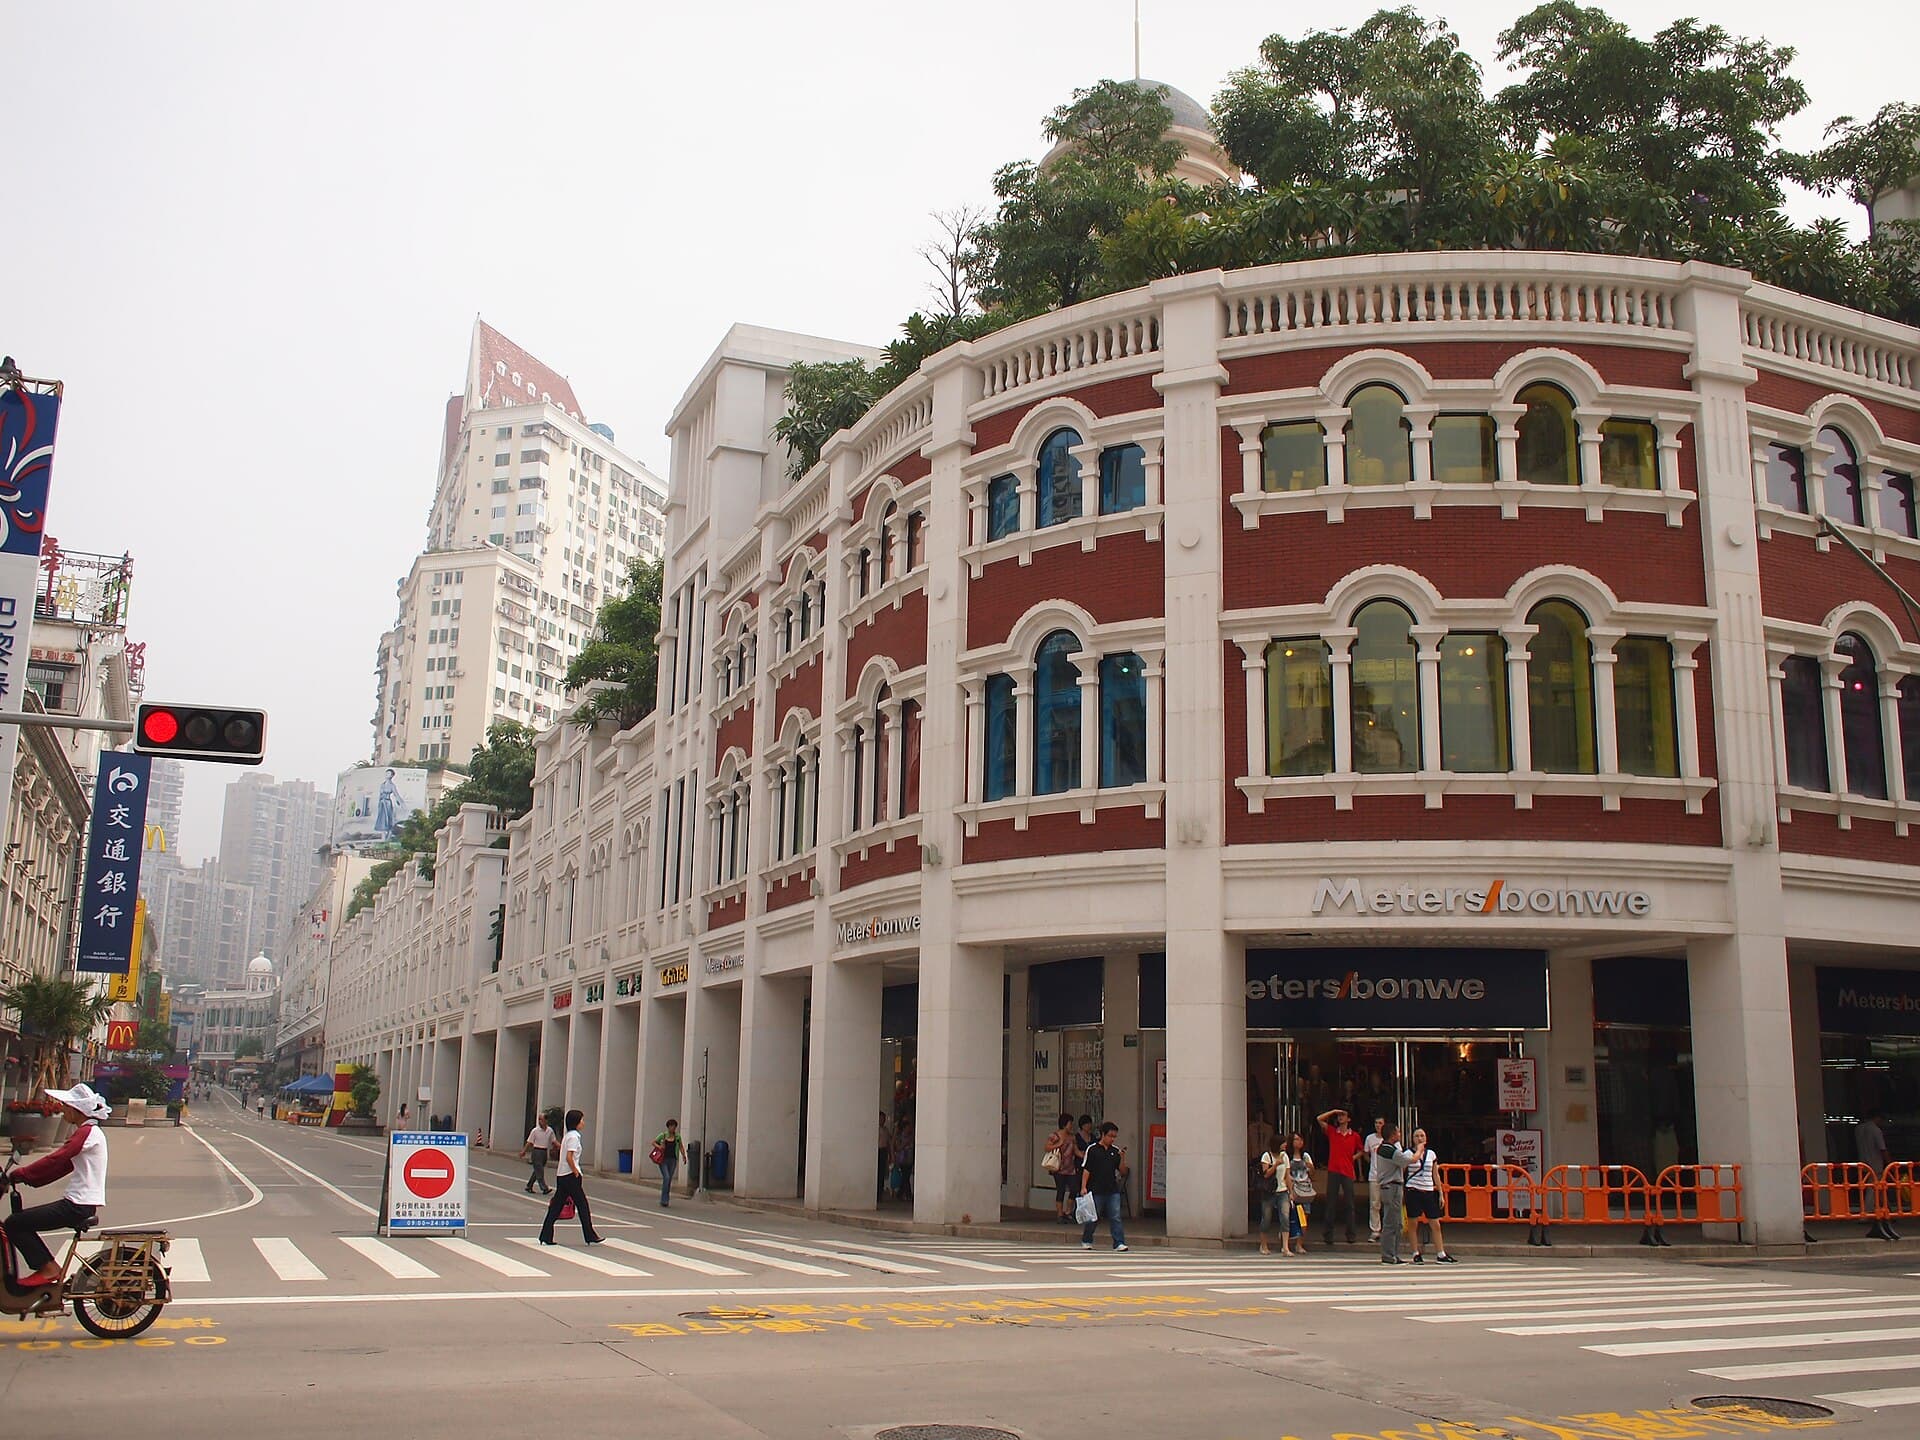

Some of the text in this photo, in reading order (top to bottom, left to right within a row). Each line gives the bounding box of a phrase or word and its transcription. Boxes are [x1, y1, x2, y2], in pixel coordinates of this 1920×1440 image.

[93, 803, 132, 929] 交通銀行
[1312, 878, 1651, 916] Meters/bonwe
[836, 914, 921, 945] Meters/bonwe
[1246, 970, 1486, 1000] eters/bonwe
